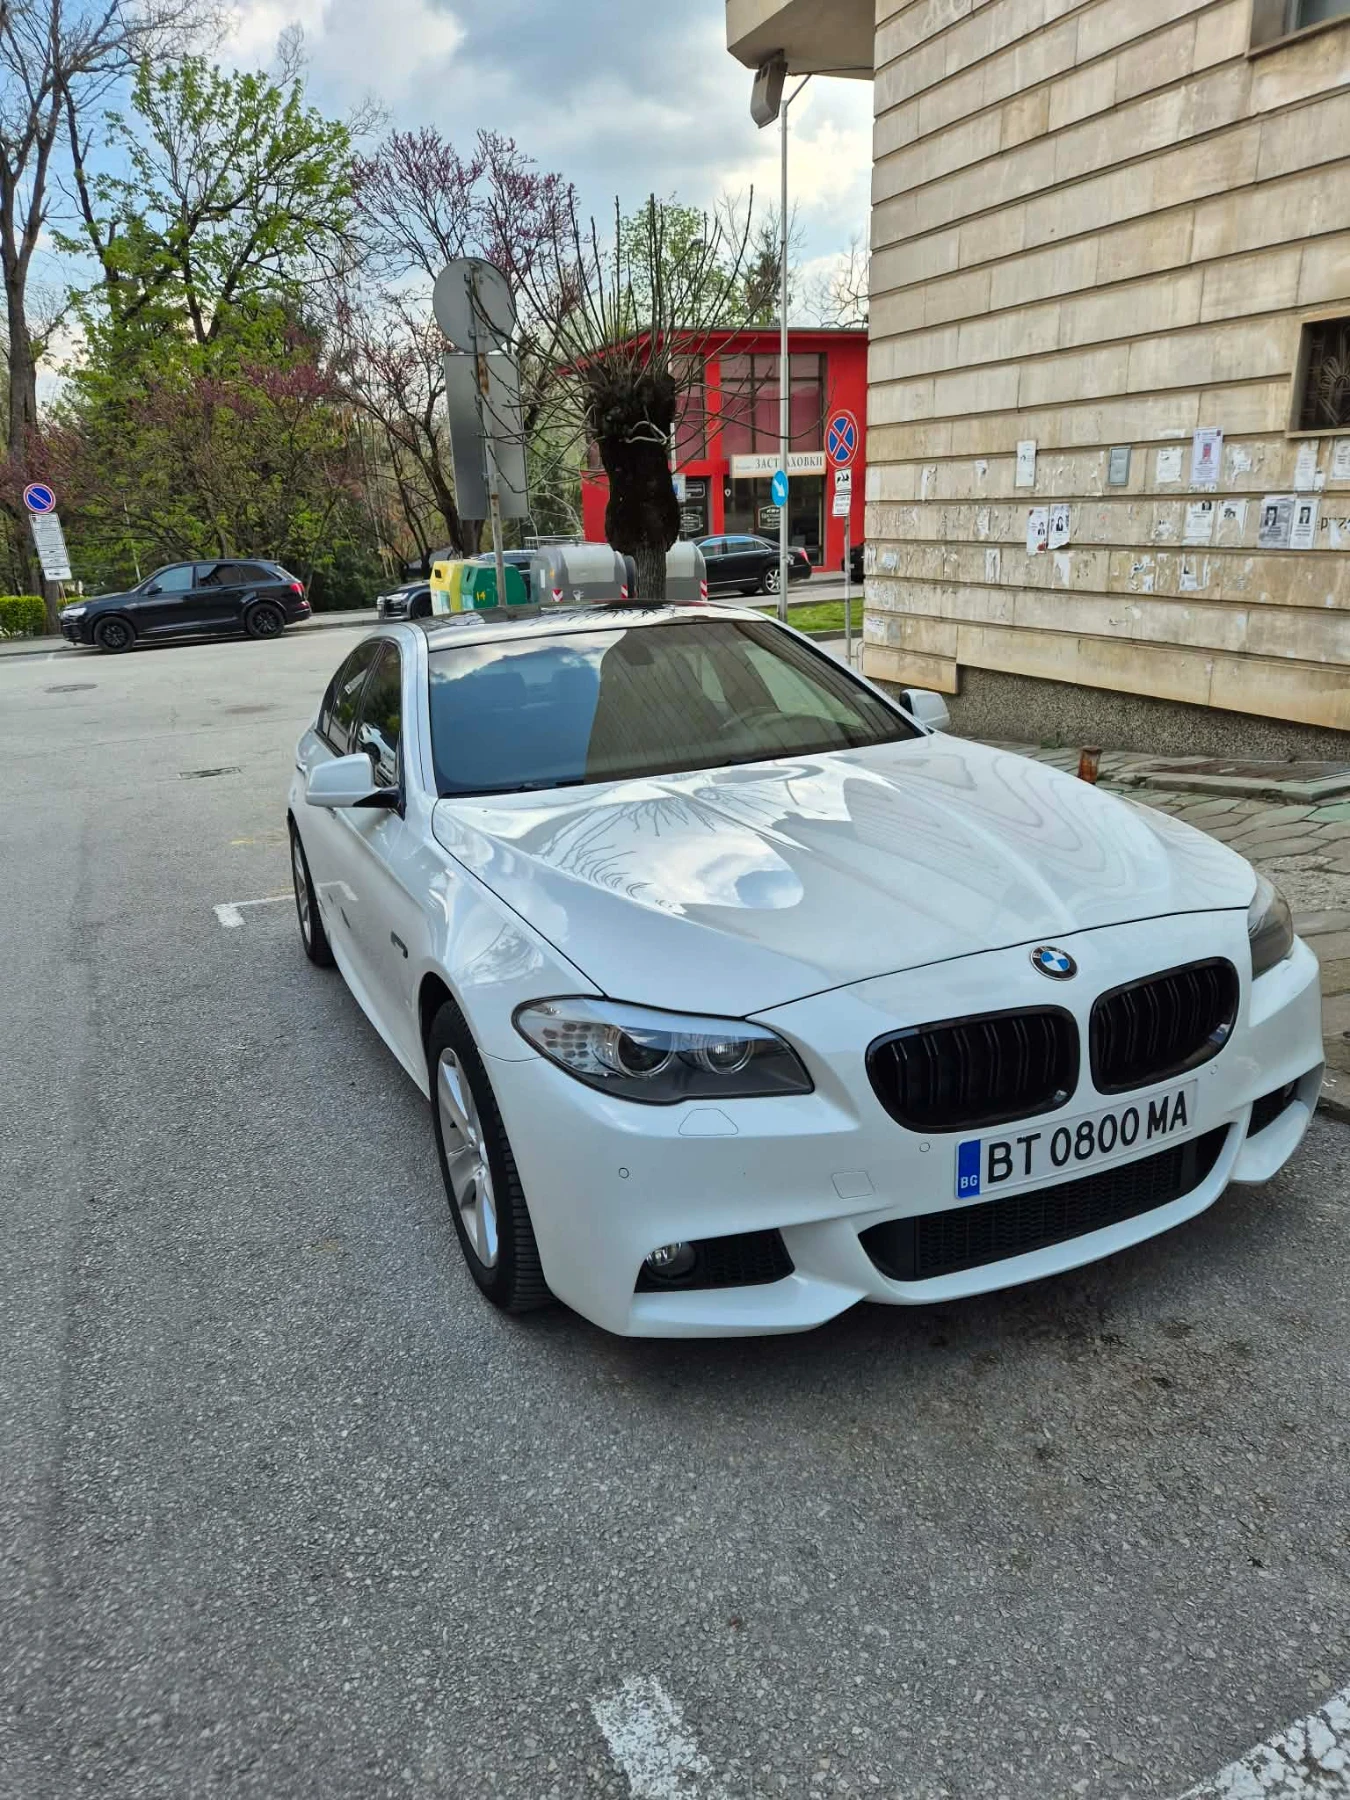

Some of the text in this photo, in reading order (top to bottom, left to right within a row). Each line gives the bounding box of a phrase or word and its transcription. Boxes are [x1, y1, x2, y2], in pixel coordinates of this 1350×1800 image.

[756, 456, 823, 469] ЗАСТАХОВКИ
[988, 1090, 1188, 1184] BT 0800 MA
[960, 1174, 979, 1189] BG
